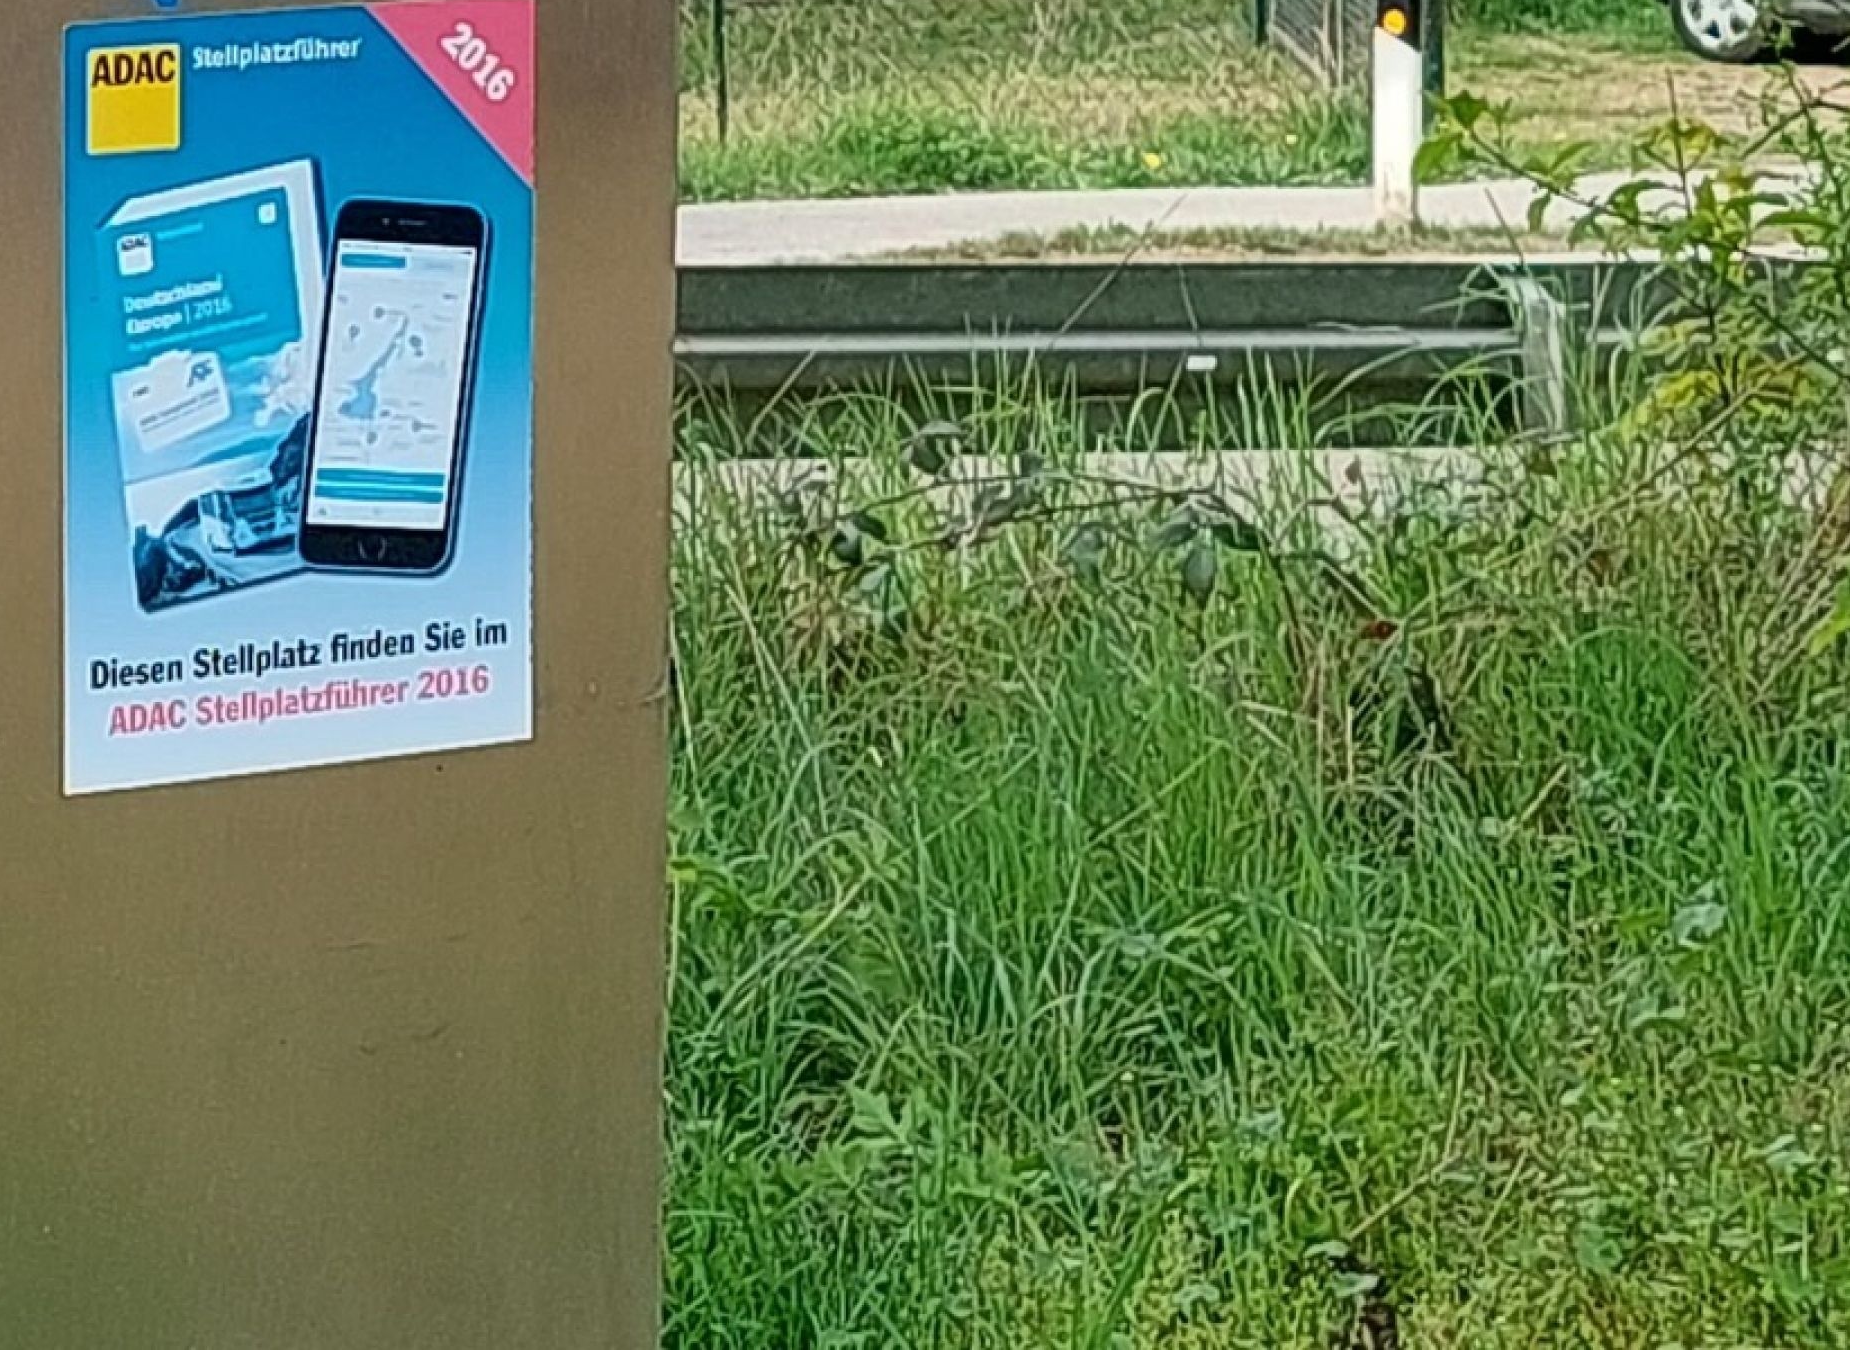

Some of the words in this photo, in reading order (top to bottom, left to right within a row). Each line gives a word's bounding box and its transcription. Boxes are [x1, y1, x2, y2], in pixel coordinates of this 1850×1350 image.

[91, 51, 176, 88] ADAC
[192, 37, 362, 71] Stellplatzführer
[440, 22, 516, 102] 2016
[90, 657, 184, 690] Diesen
[193, 639, 321, 678] Stellplatz
[331, 630, 415, 663] finden
[424, 621, 466, 652] Sie
[475, 617, 508, 648] im
[109, 698, 187, 736] ADAC
[196, 677, 409, 725] Stellplatzführer
[417, 664, 490, 700] 2016
